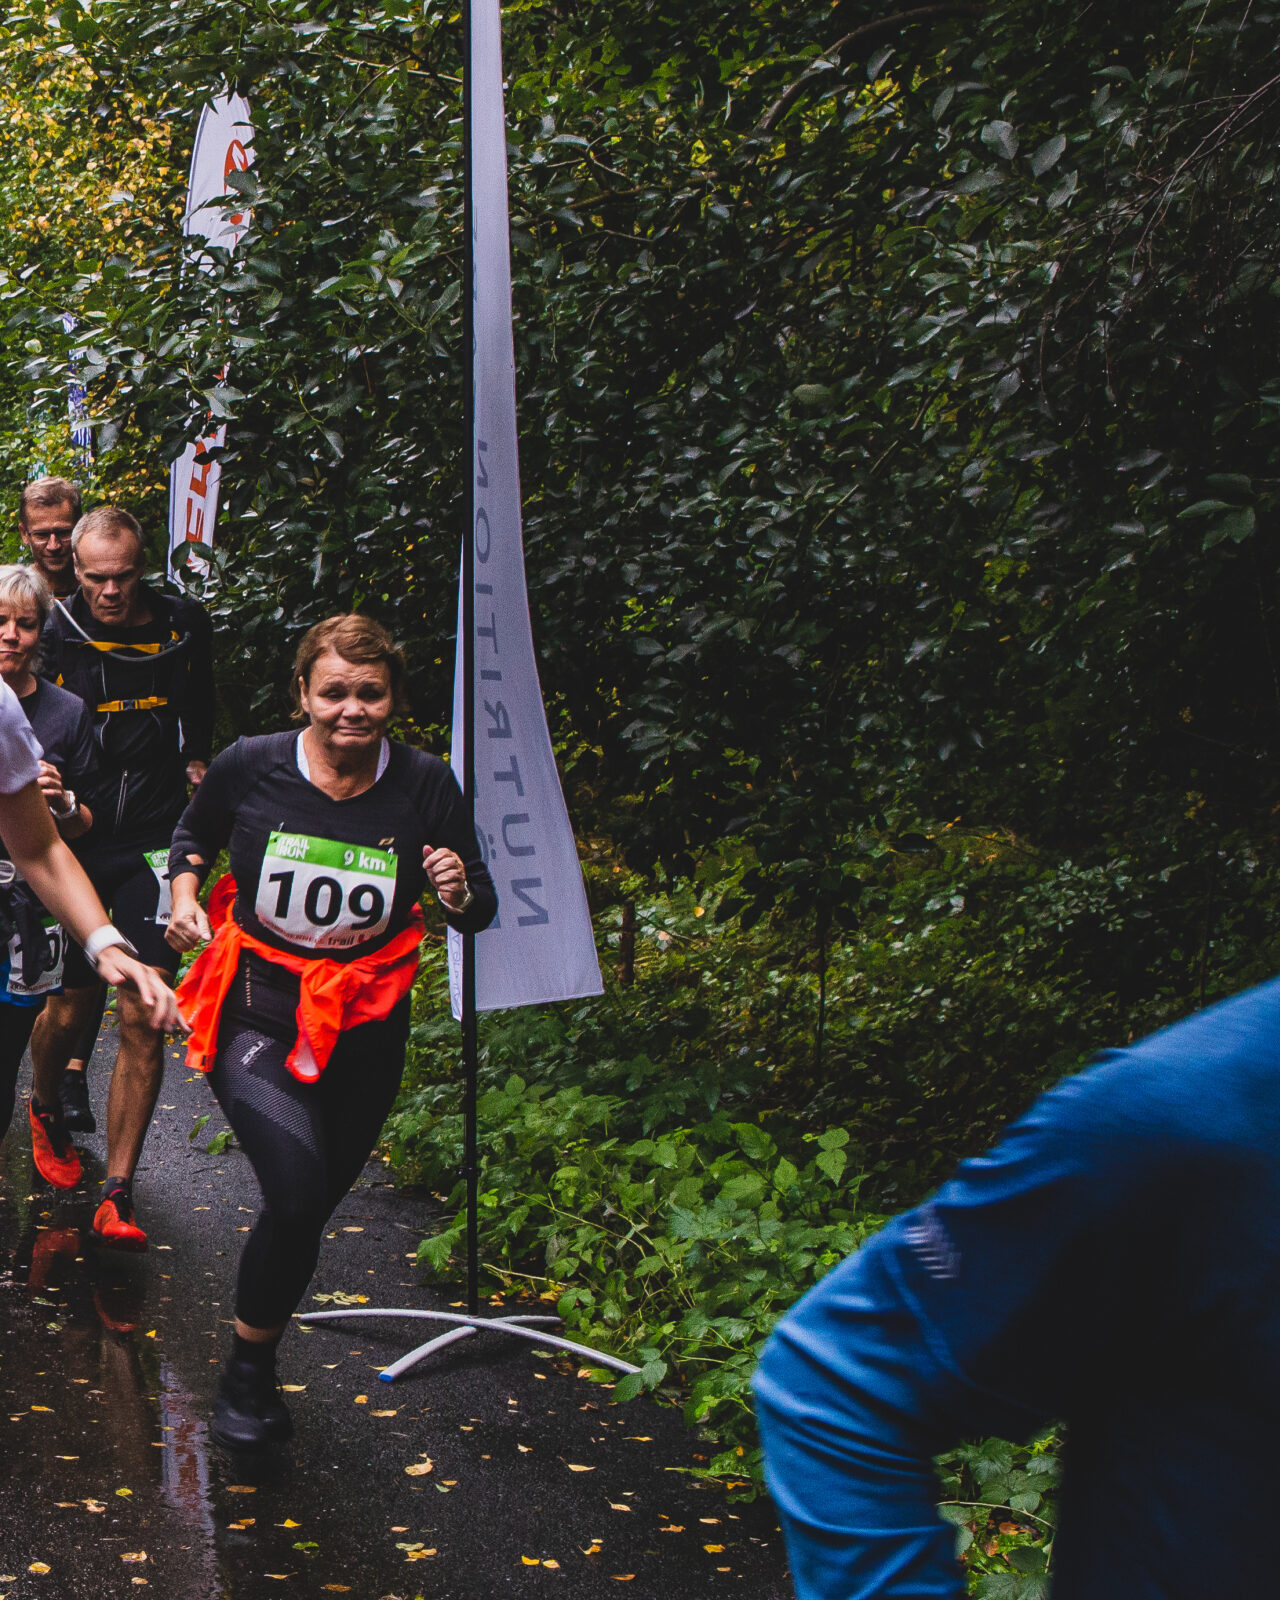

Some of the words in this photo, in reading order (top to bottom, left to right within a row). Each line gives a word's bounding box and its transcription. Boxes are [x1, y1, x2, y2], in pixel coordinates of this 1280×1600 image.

[343, 849, 355, 867] 9
[358, 851, 387, 873] km
[268, 870, 385, 931] 109
[328, 935, 355, 946] trail
